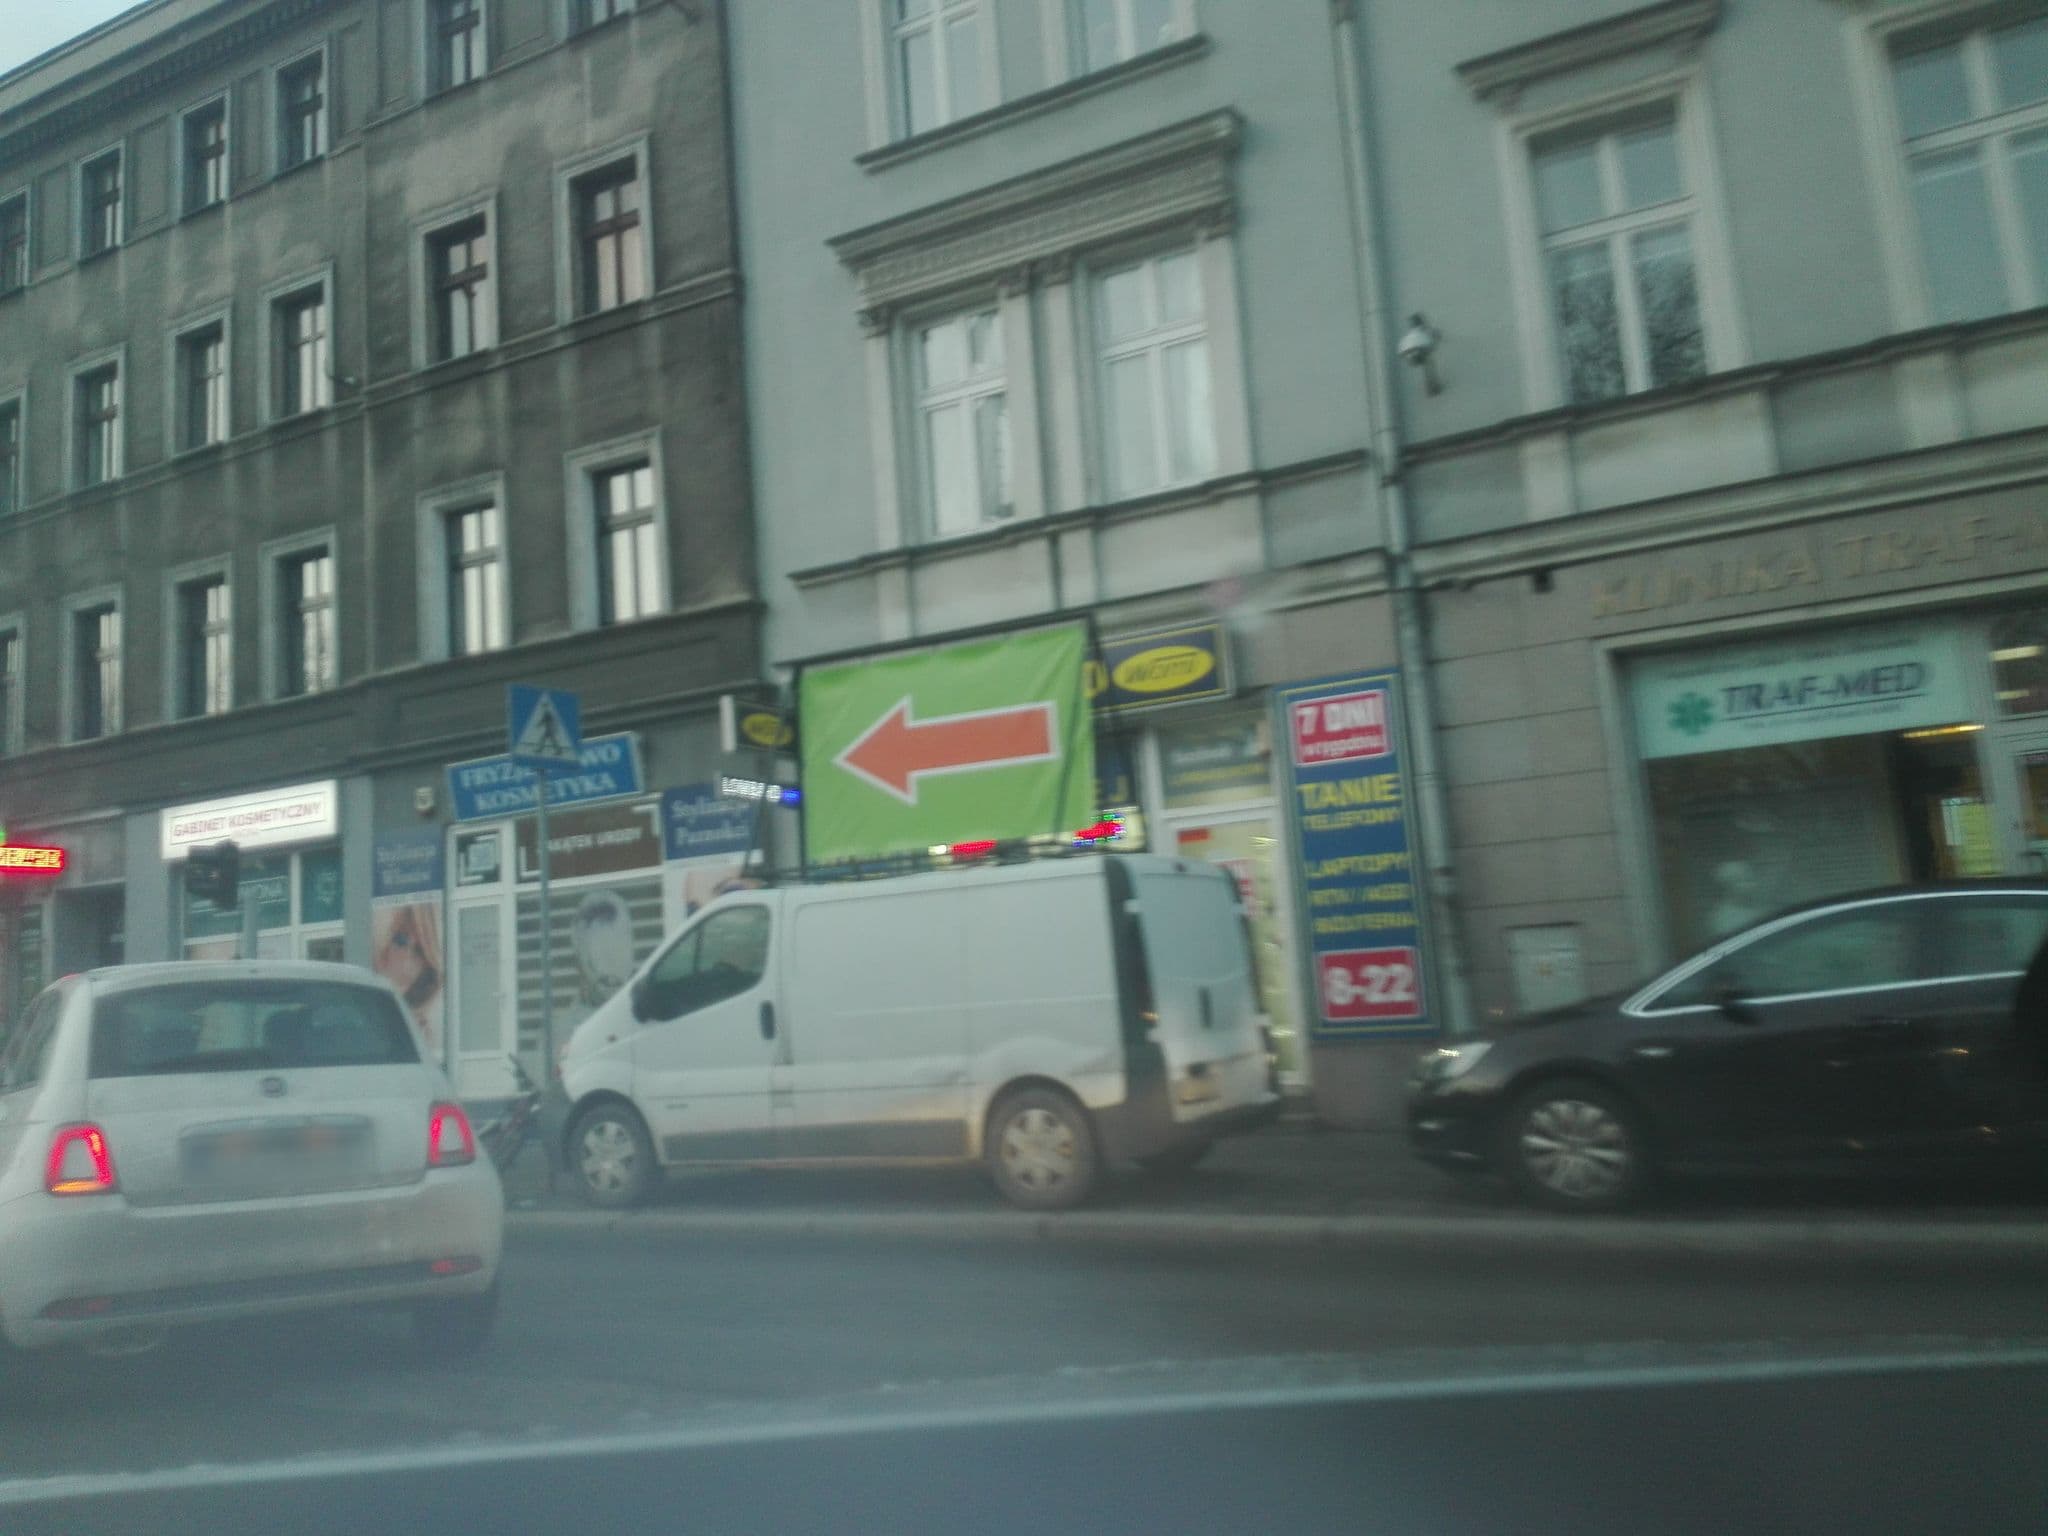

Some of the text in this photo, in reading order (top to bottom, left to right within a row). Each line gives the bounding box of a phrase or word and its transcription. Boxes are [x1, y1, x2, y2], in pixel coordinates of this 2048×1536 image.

[1721, 663, 1929, 714] TRAF-MED
[1296, 699, 1384, 735] 7 DNI
[476, 773, 615, 811] KOSMETYKA
[1296, 774, 1402, 809] TANIE
[174, 803, 322, 838] GABINET KOSMETYCZNY
[1302, 807, 1401, 831] TELEFONY
[1326, 964, 1417, 1006] 8-22
